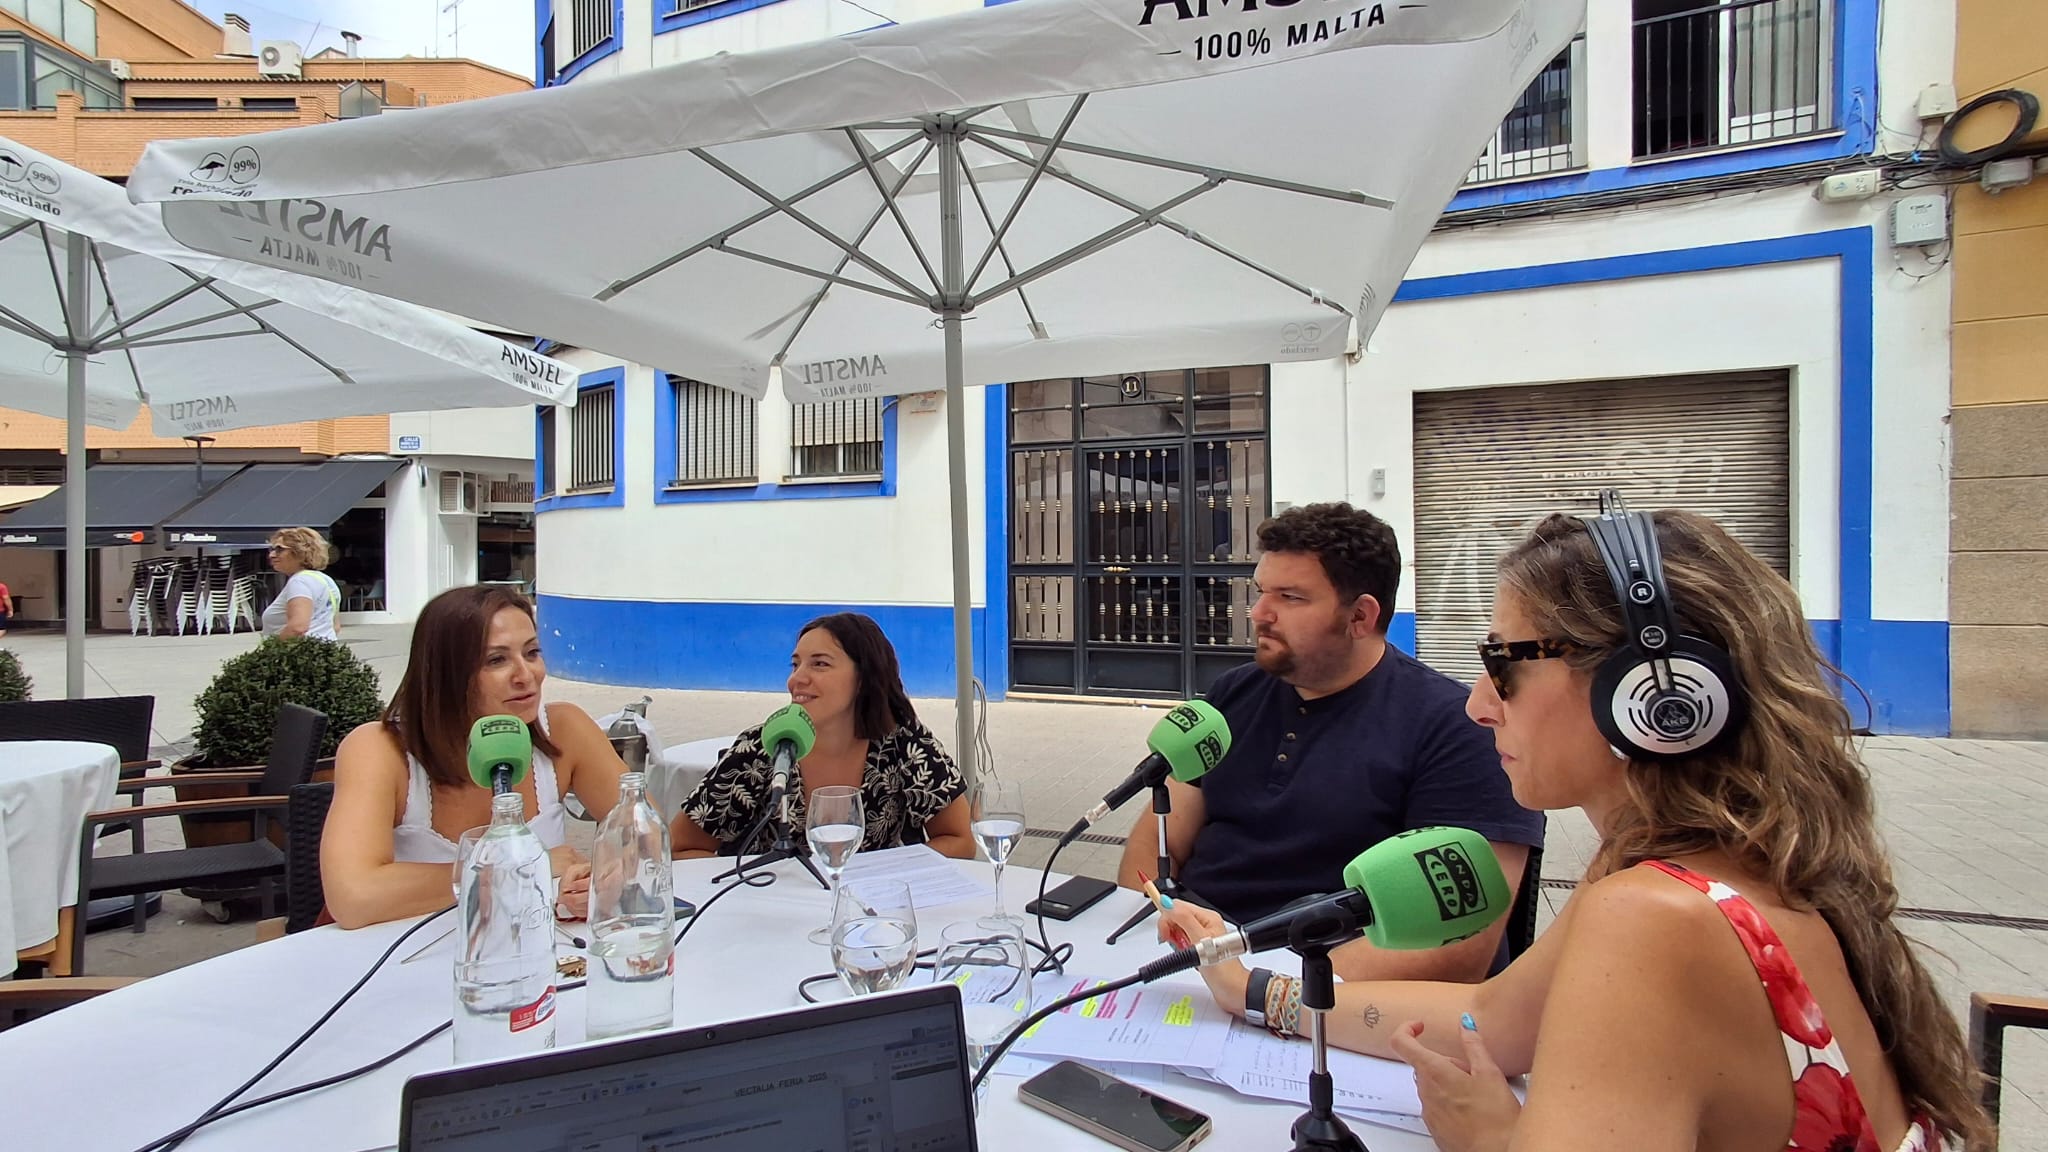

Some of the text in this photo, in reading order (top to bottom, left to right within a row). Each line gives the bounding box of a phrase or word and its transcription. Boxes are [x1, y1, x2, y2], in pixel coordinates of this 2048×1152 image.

[1194, 27, 1271, 61] 100%
[1286, 3, 1385, 48] MALTA
[233, 160, 257, 173] 99%
[32, 170, 57, 186] 99%
[0, 190, 61, 216] eciclado
[501, 344, 565, 386] AMSTEL
[1125, 381, 1138, 393] 11
[1637, 587, 1648, 597] R
[1661, 716, 1690, 727] AKG
[1430, 859, 1457, 908] CERO
[1448, 852, 1475, 904] ONDA
